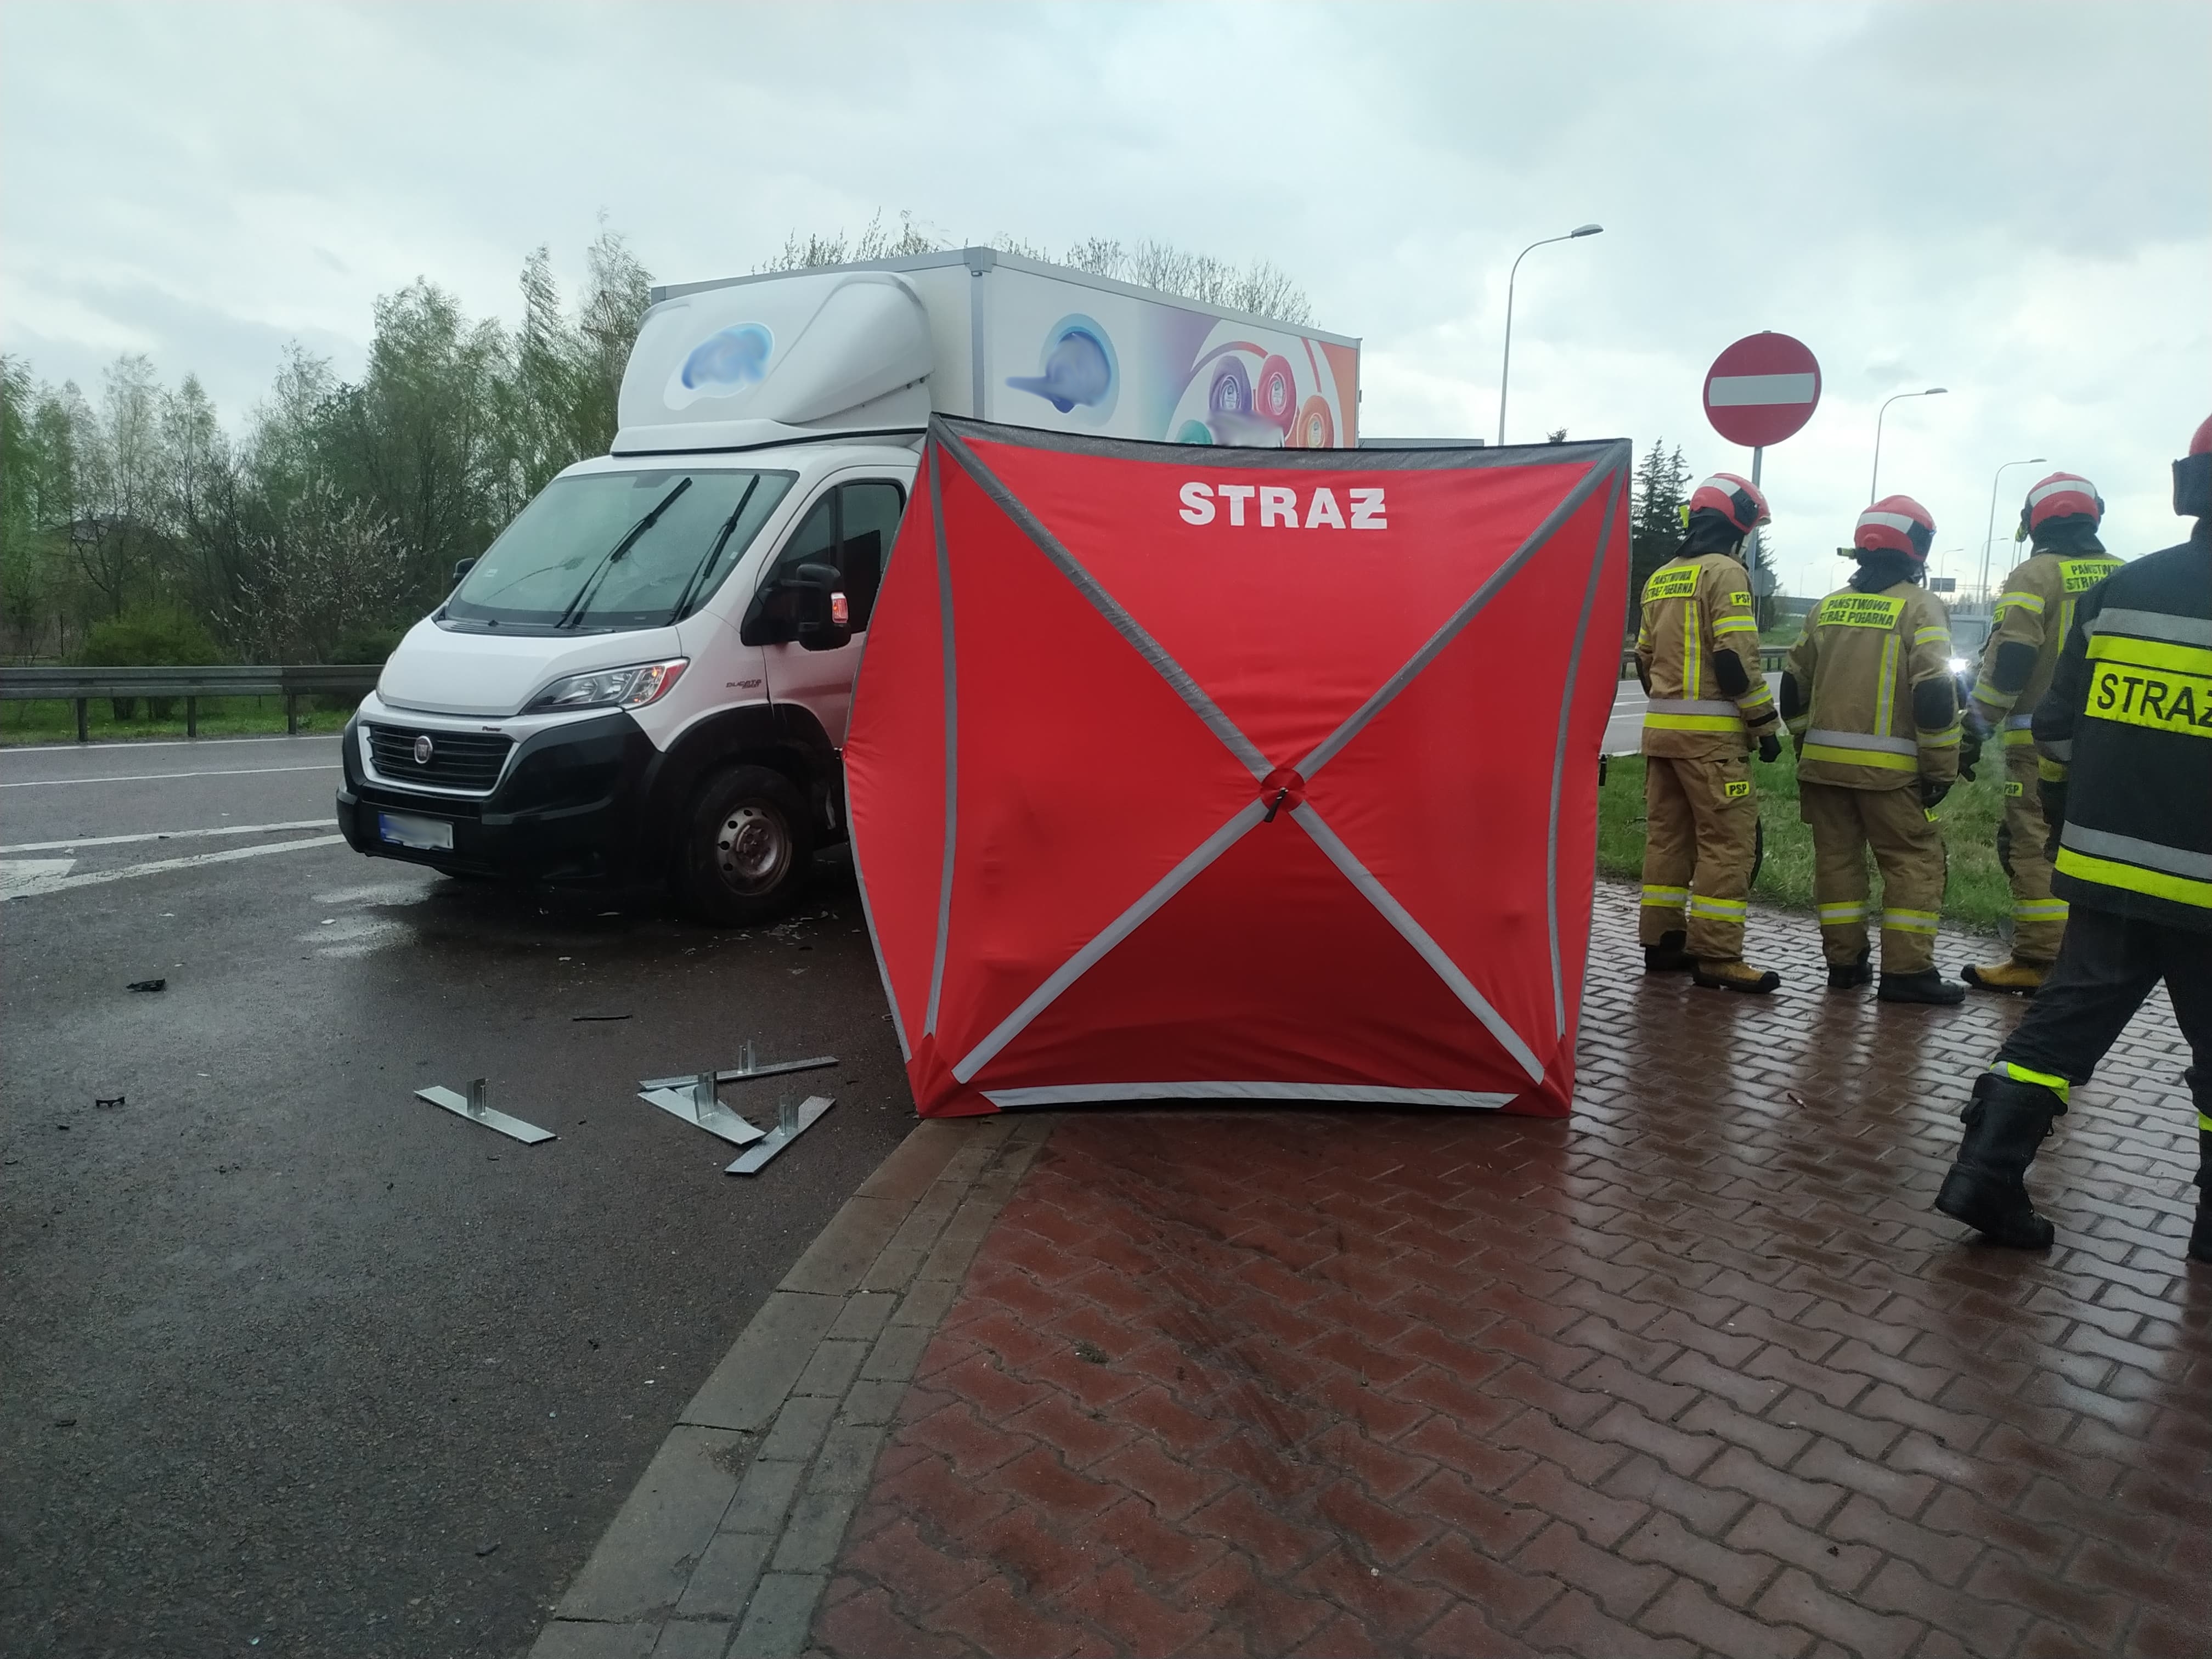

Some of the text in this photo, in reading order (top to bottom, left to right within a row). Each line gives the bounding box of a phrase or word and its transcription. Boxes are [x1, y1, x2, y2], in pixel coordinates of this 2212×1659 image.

[1826, 596, 1892, 612] PAŃSTWOWA
[417, 744, 428, 757] FIAT
[1729, 783, 1747, 795] PSP
